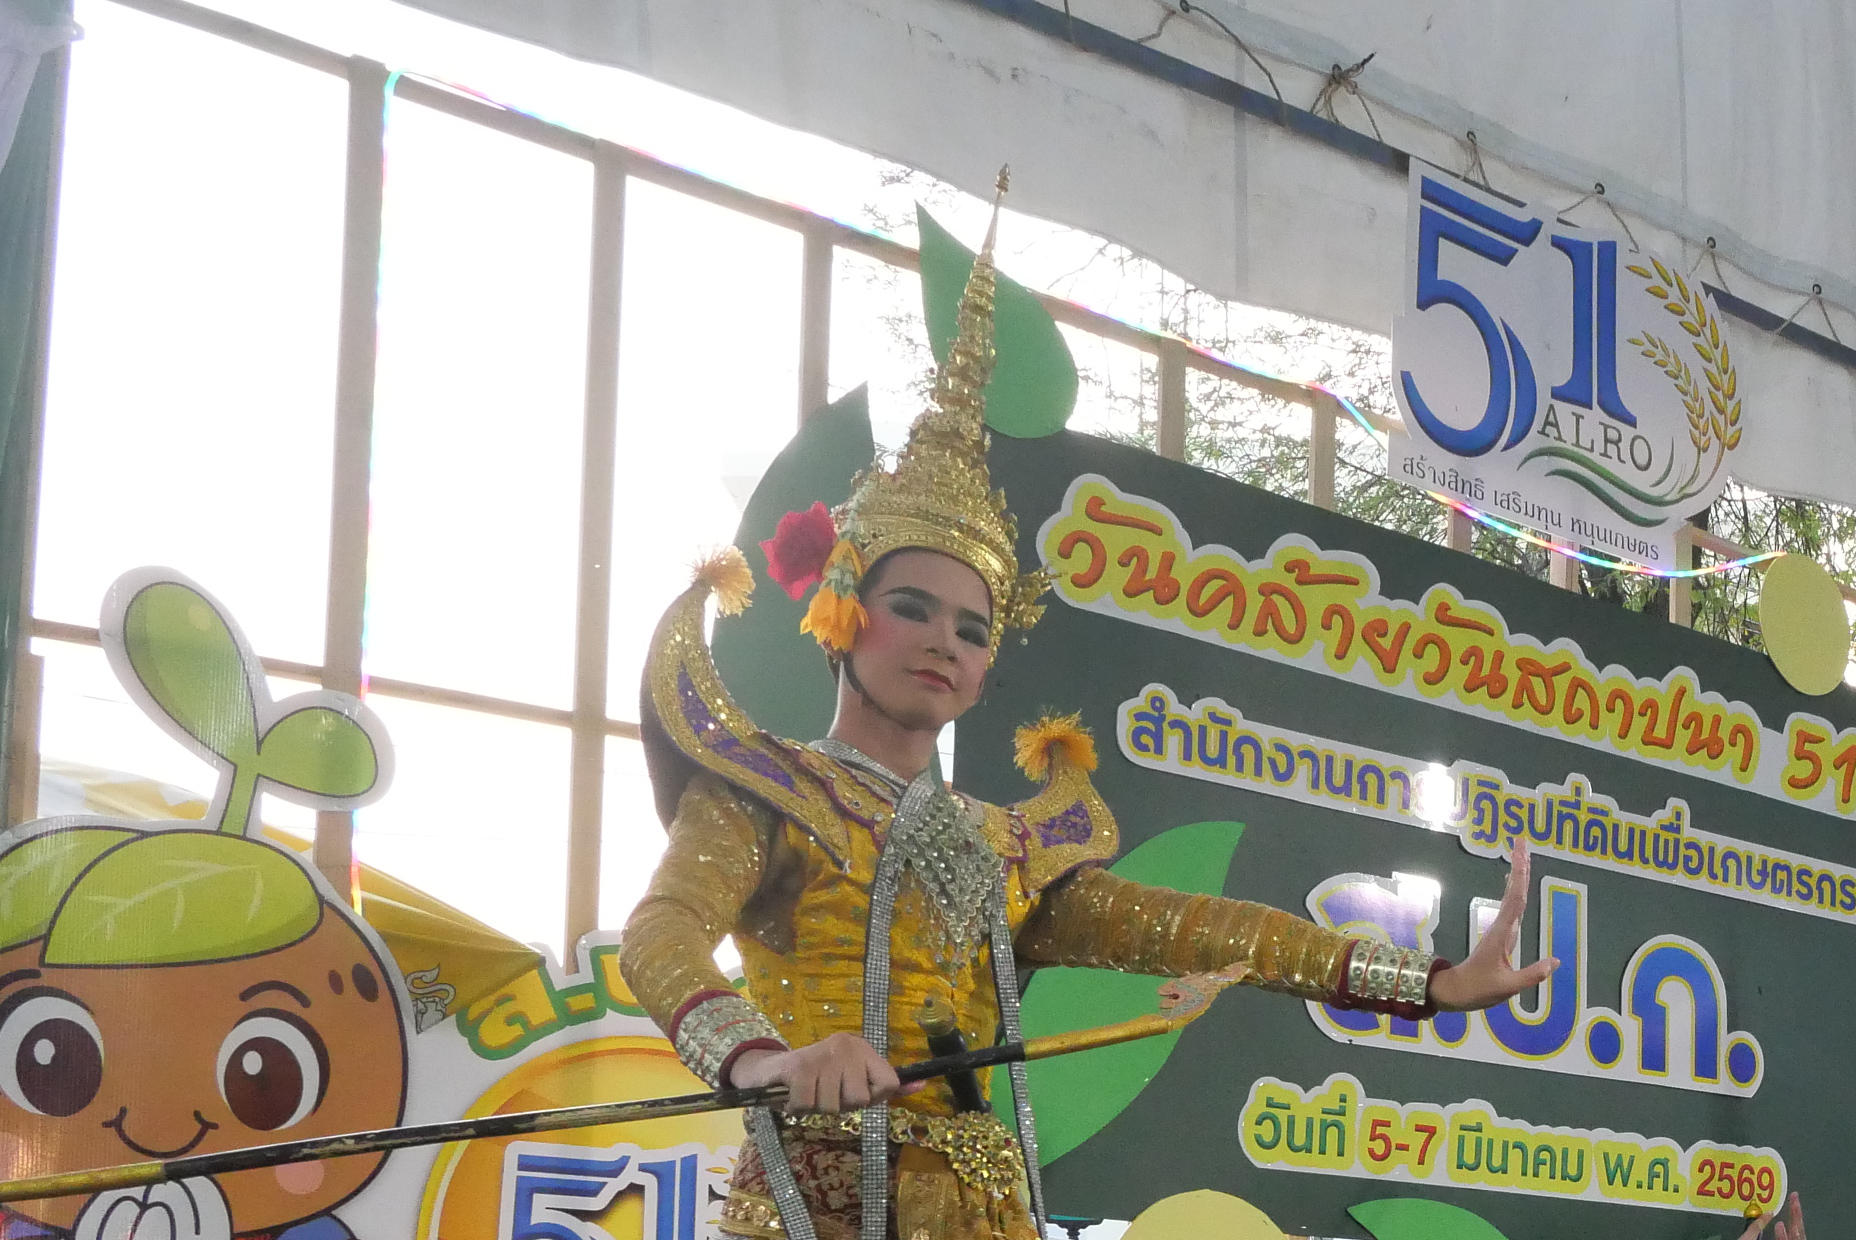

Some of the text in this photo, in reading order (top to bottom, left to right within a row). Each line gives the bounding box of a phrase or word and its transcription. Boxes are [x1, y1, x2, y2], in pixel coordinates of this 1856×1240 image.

[1401, 175, 1637, 458] 51
[1537, 403, 1653, 472] ALRO
[1402, 454, 1660, 561] สร้างสิทธิ เสริมทุน หนุนเกษตร
[1057, 495, 1755, 773] วันคล้ายวันสถาปนา
[1254, 1093, 1776, 1204] วันที่ 5-7 มีนาคม พ.ศ. 2569
